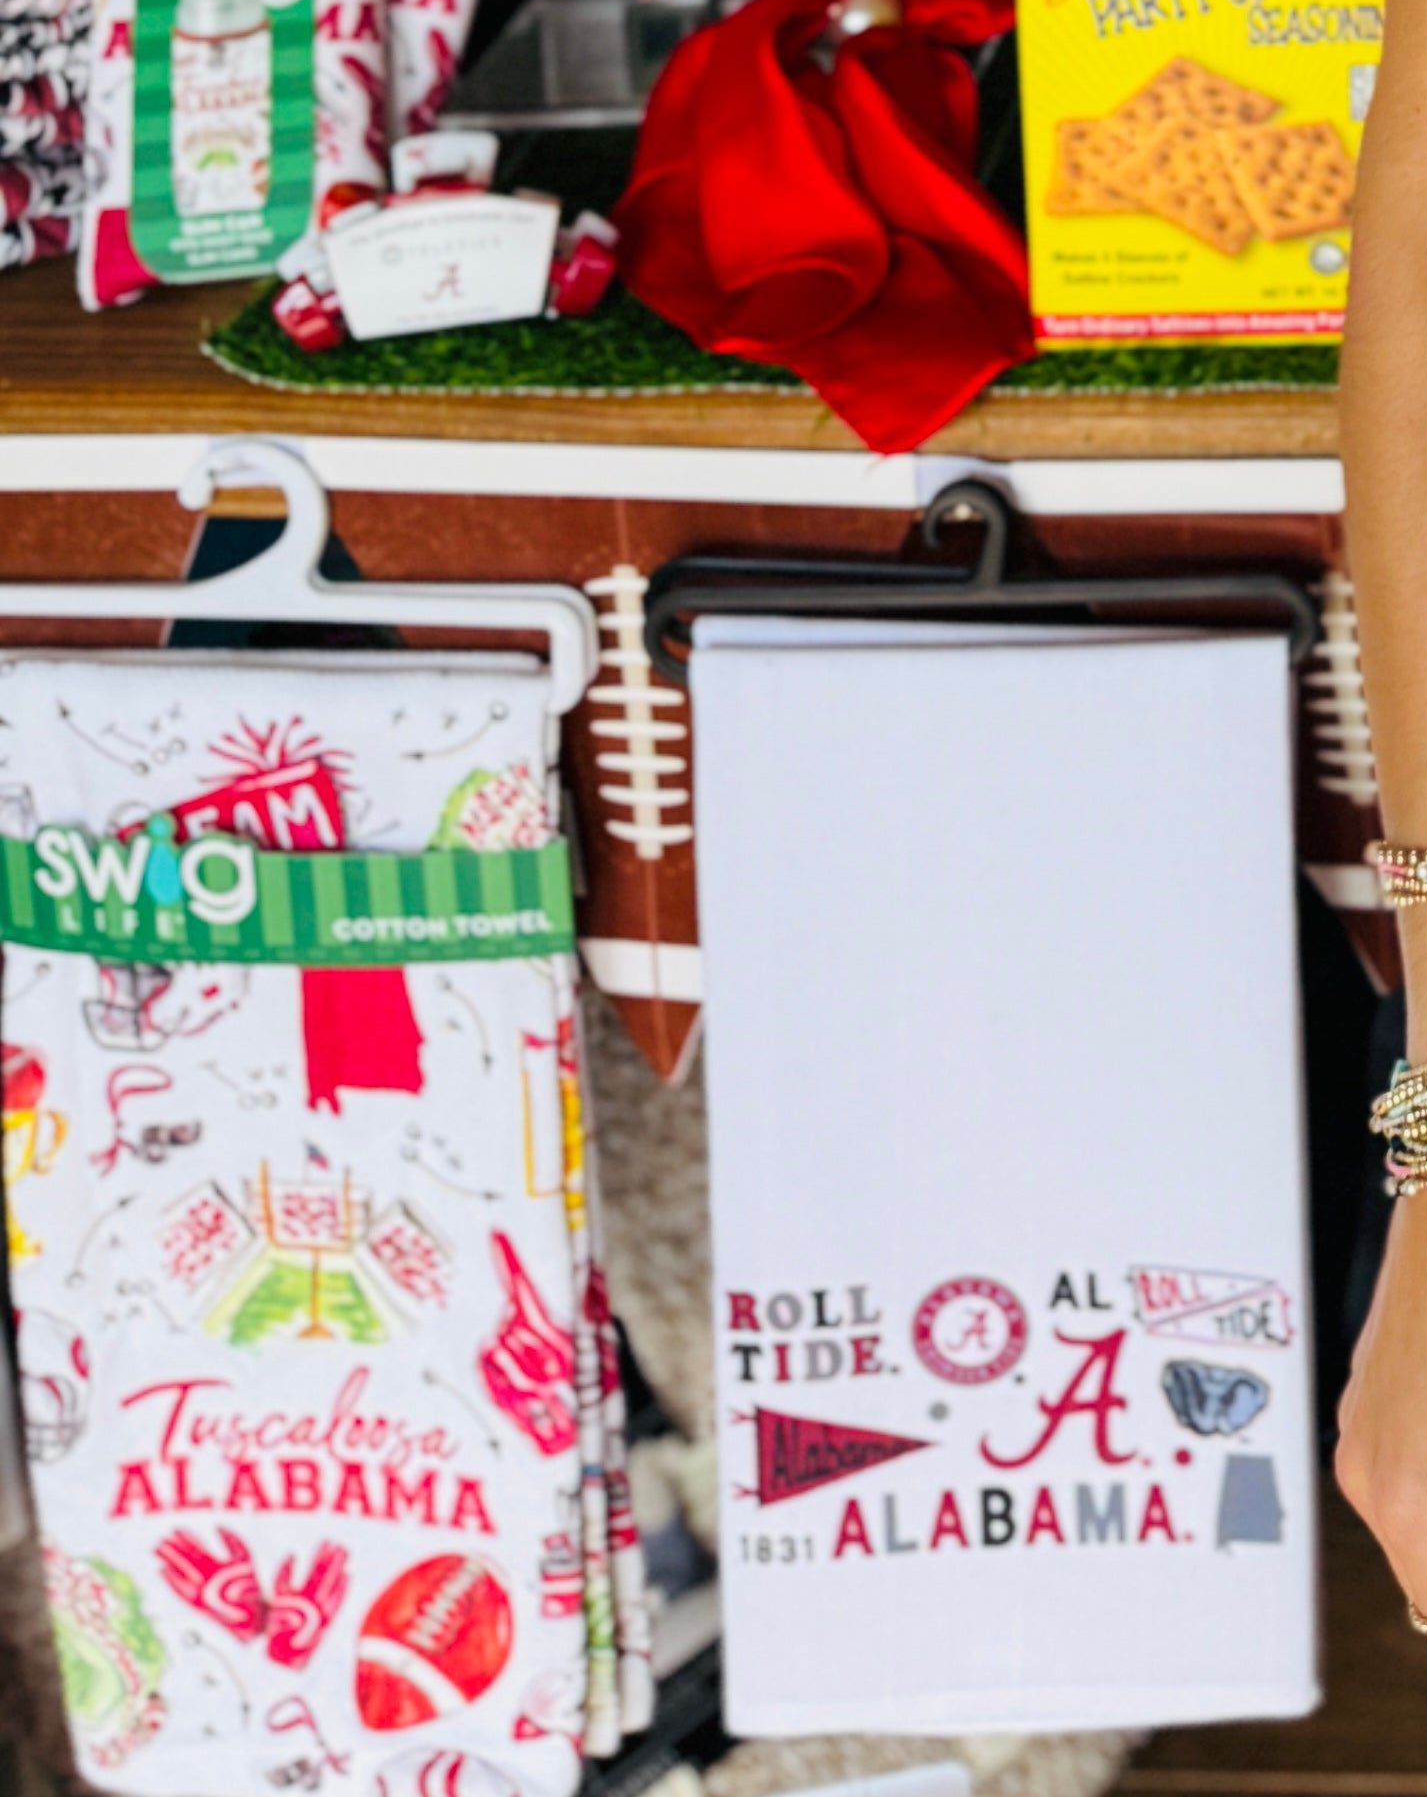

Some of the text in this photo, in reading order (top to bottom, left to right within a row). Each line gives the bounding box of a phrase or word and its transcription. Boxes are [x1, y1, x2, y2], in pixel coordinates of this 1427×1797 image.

[331, 908, 553, 942] COTTON TOWEL
[727, 1285, 882, 1333] ROLL
[1049, 1270, 1114, 1310] AL
[118, 1365, 460, 1467] Tuscaloosa
[107, 1455, 498, 1536] ALABAMA
[738, 1535, 815, 1564] 1831
